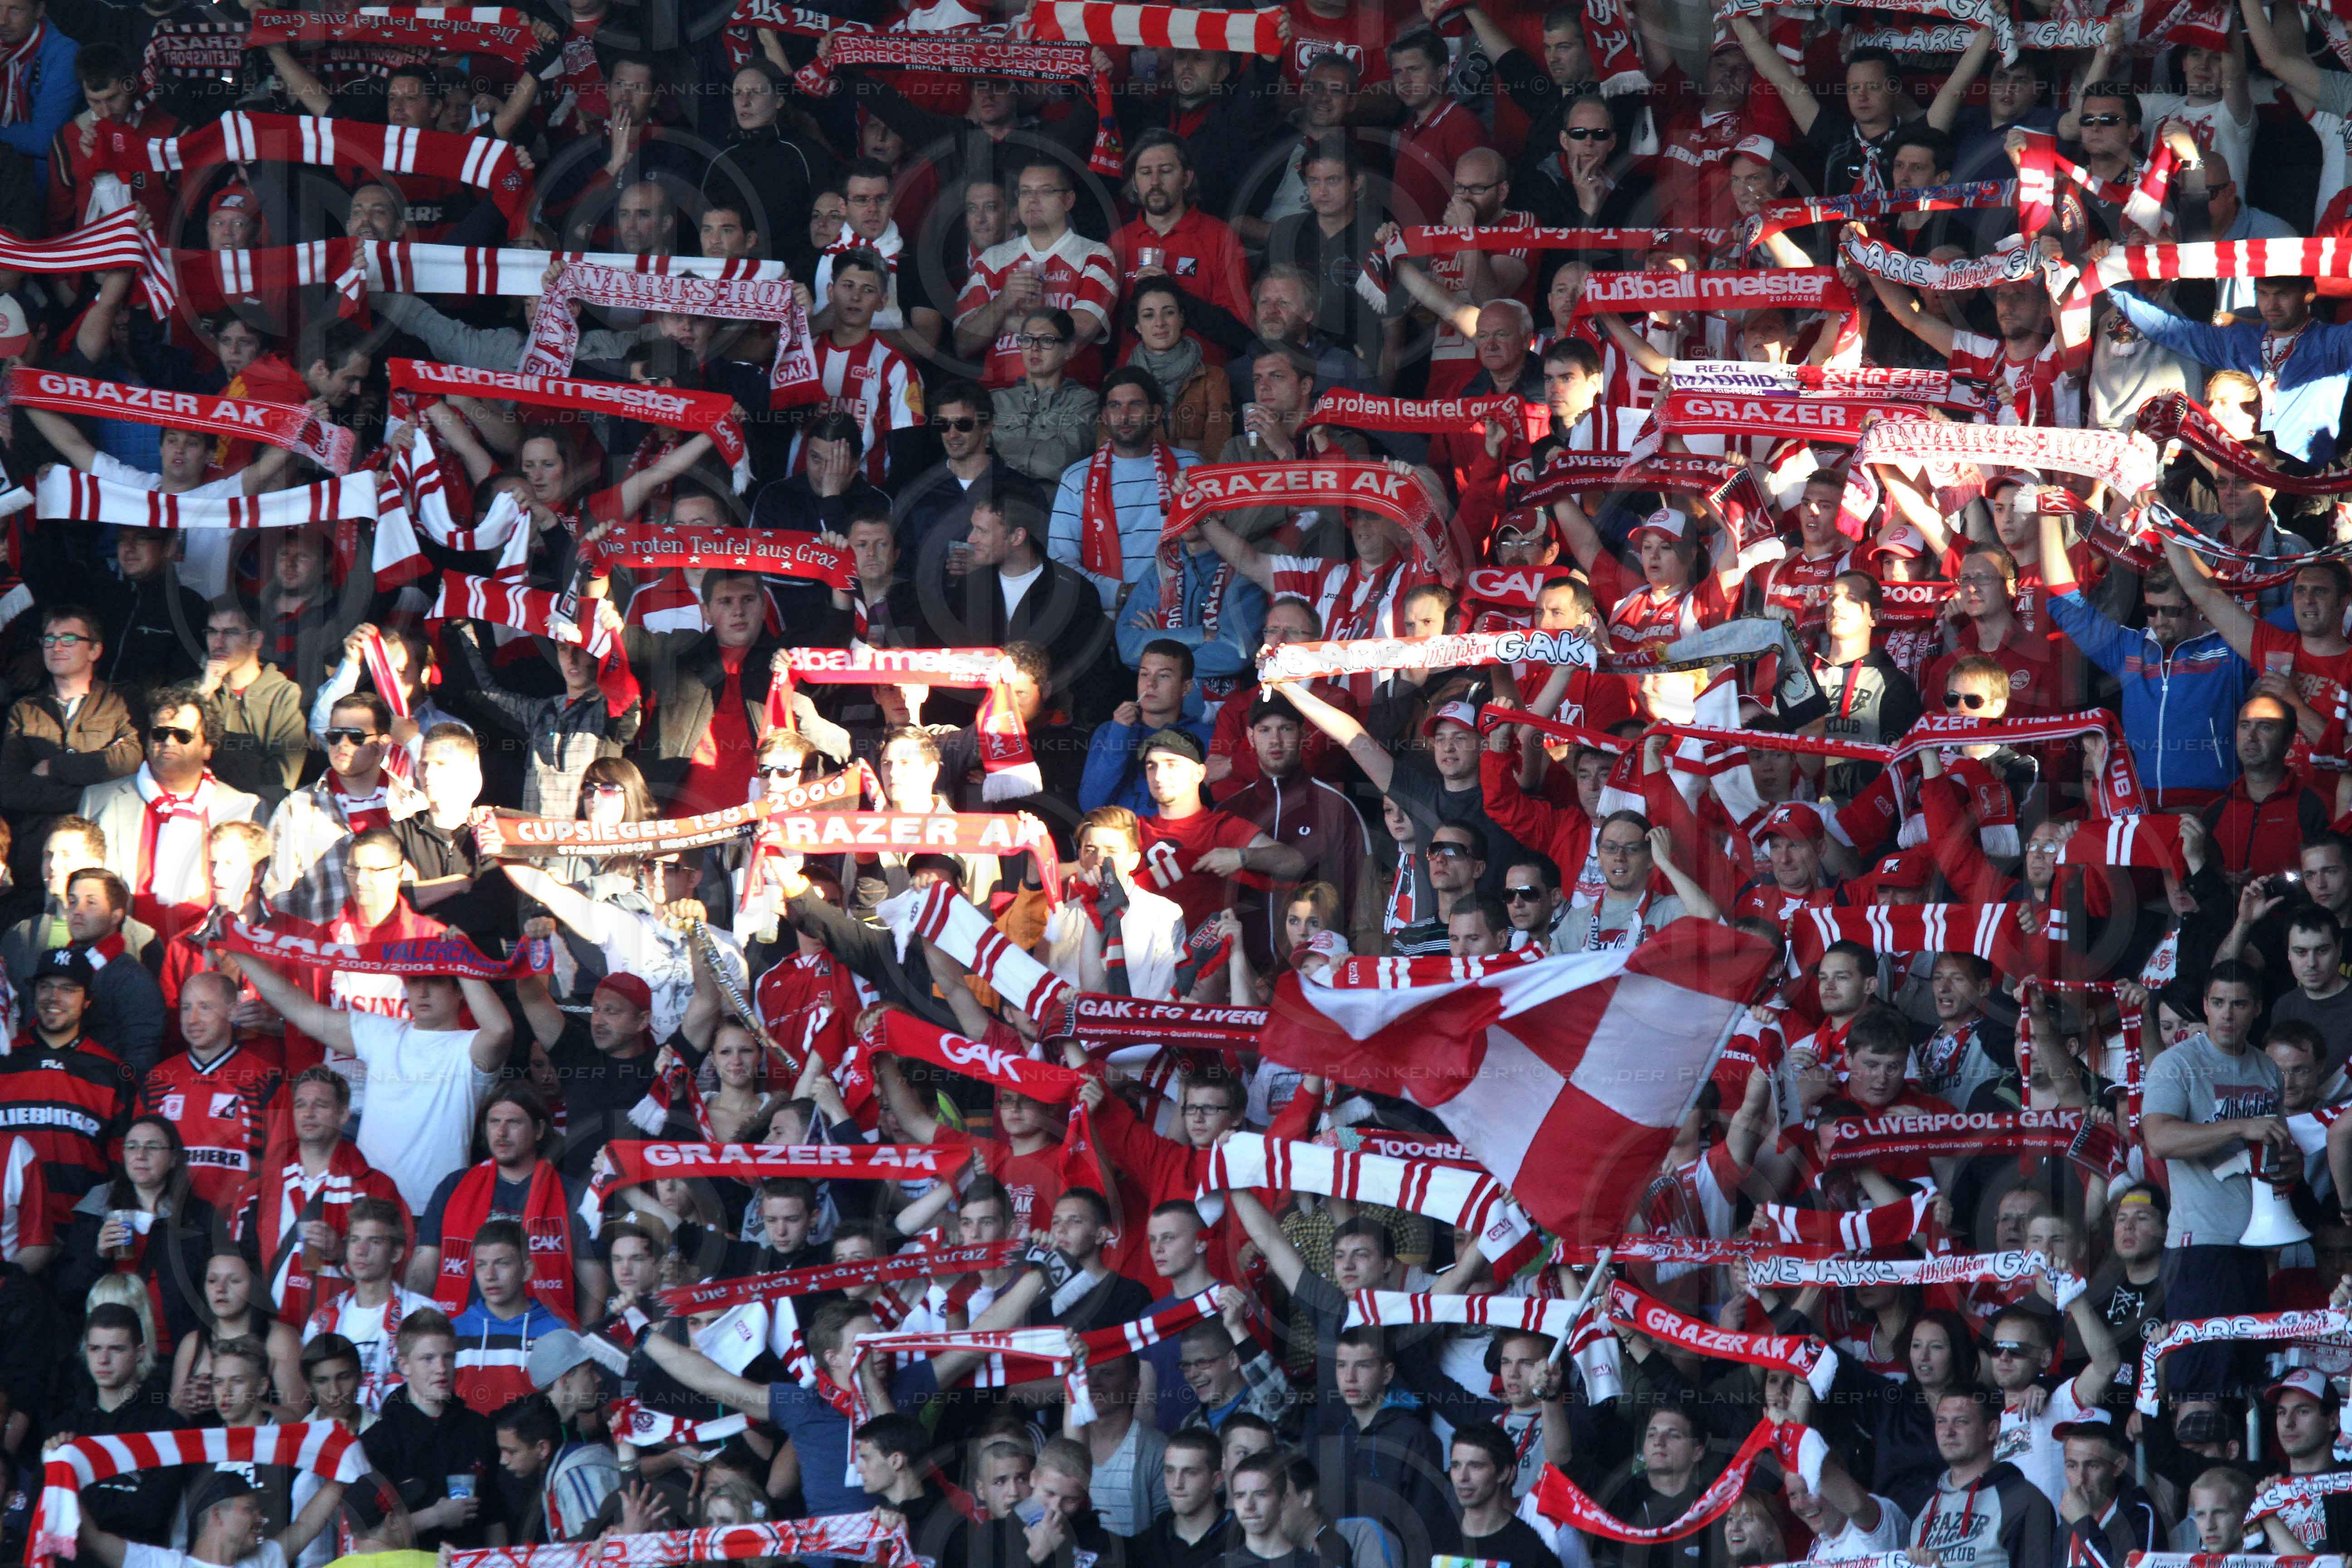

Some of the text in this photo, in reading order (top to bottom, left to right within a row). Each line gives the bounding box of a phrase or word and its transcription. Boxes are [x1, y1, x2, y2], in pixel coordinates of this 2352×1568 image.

[1905, 25, 1972, 52] ARE
[2034, 20, 2108, 48] GAK
[985, 45, 1085, 60] CUPSIEGER
[1002, 69, 1035, 77] IMMER
[1587, 273, 1833, 302] fußball meister
[775, 356, 809, 384] GAK
[1672, 374, 1776, 387] MADRID
[1695, 364, 1746, 373] REAL
[1821, 367, 1949, 378] GRAZER
[411, 362, 696, 412] fußball meister
[39, 375, 270, 427] GRAZER AK
[1337, 393, 1390, 415] roten
[1684, 398, 1847, 426] GRAZER
[1180, 470, 1408, 511] GRAZER AK
[598, 536, 839, 570] Die roten Teufel aus Graz
[1495, 631, 1587, 665] GAK
[518, 777, 847, 842] CUPSIEGER 1981 2000
[1078, 1000, 1135, 1019] GAK
[1151, 1006, 1185, 1019] FC
[1077, 1027, 1122, 1037] Champions
[1129, 1029, 1162, 1038] League
[40, 1058, 66, 1070] FILA
[939, 1033, 1023, 1083] GAK
[1863, 1112, 2001, 1136] LIVERPOOL
[2019, 1109, 2082, 1131] GAK
[642, 1144, 944, 1171] GRAZER AK
[1888, 1142, 1920, 1153] League
[529, 1235, 564, 1252] GAK
[533, 1279, 564, 1290] 1902
[1746, 1256, 1901, 1287] WE ARE
[1646, 1307, 1789, 1361] GRAZER AK
[2171, 1316, 2256, 1344] ARE
[1941, 1547, 1976, 1562] KLUB
